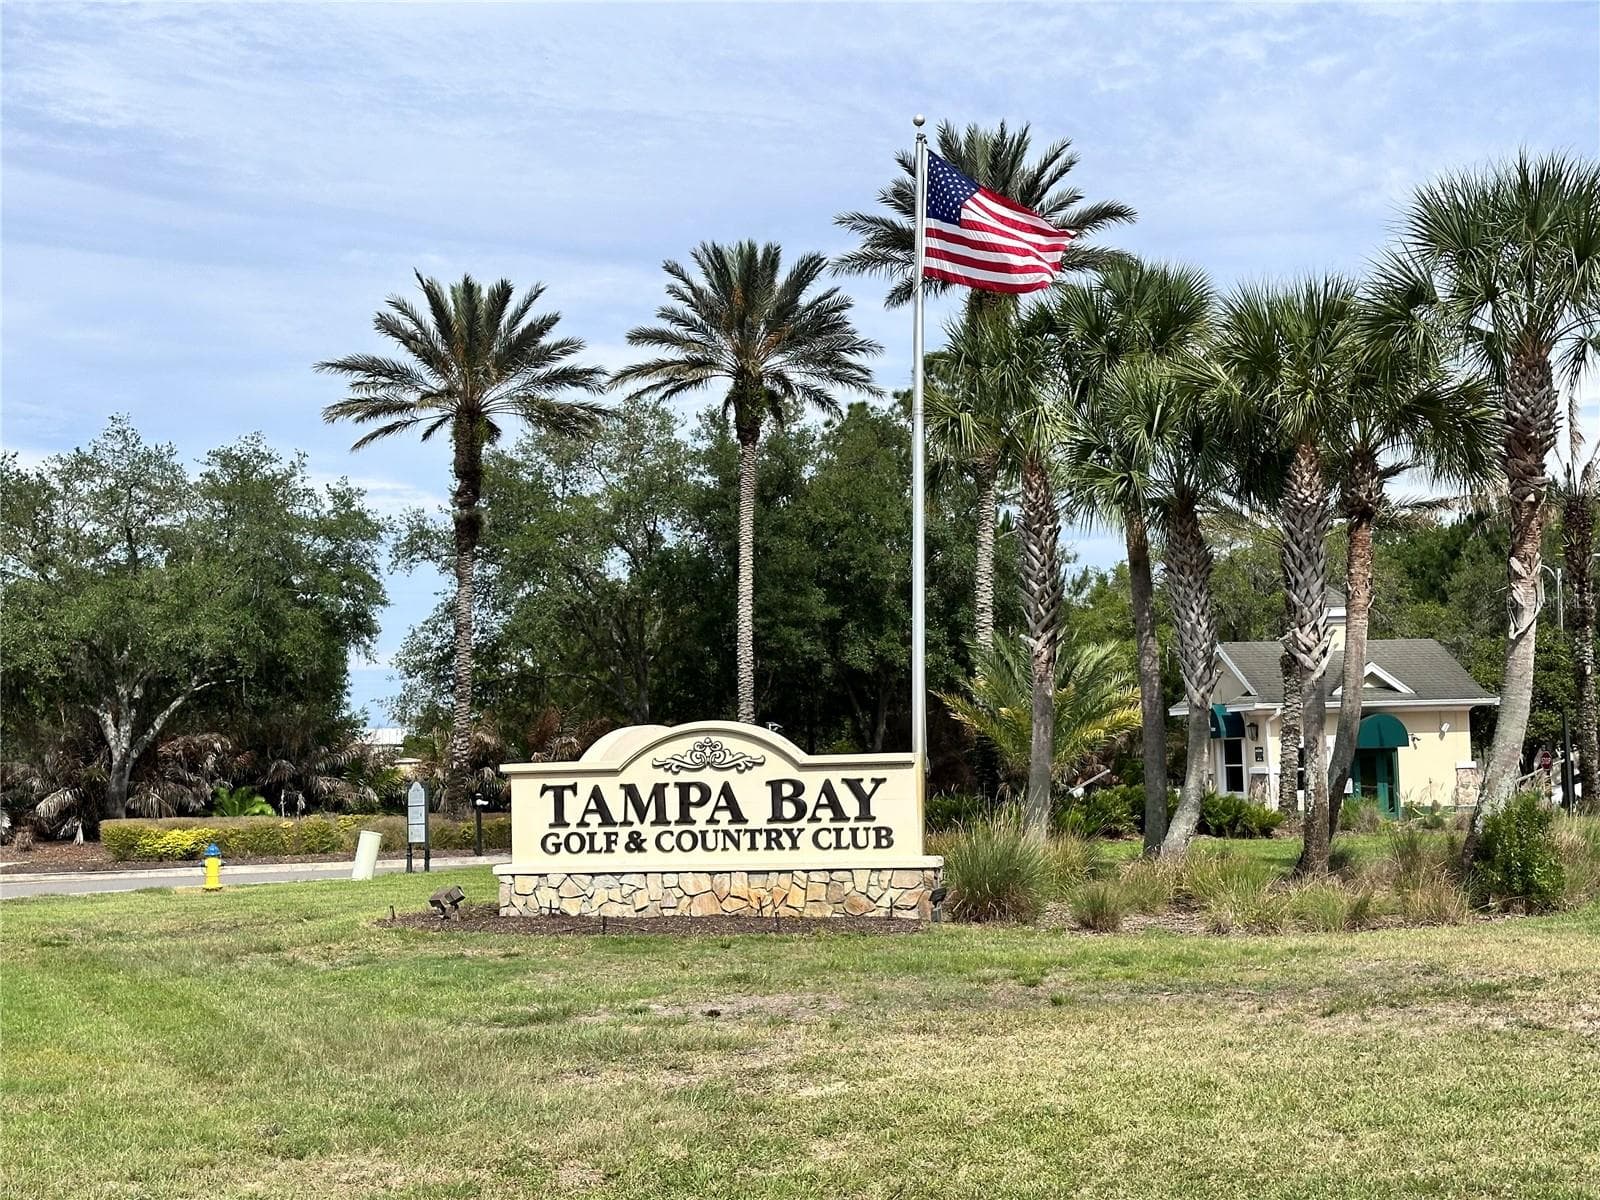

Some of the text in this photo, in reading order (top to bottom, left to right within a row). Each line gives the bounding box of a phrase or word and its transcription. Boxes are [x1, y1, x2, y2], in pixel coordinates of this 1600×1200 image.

[540, 777, 887, 828] TAMPA BAY
[540, 826, 894, 855] GOLF & COUNTRY CLUB
